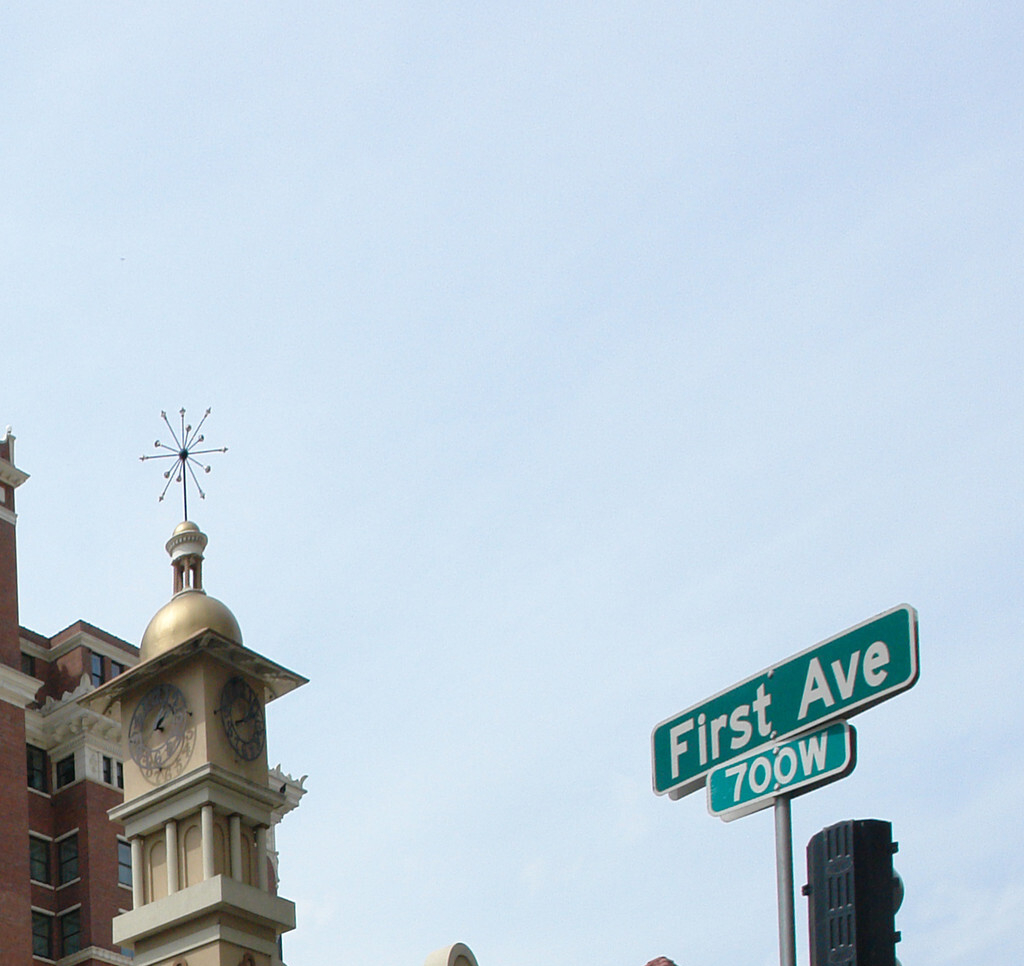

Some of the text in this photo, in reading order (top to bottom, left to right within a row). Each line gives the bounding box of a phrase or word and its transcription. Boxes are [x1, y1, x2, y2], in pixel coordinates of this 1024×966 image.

[669, 640, 891, 779] First Ave
[724, 731, 829, 802] 700W
